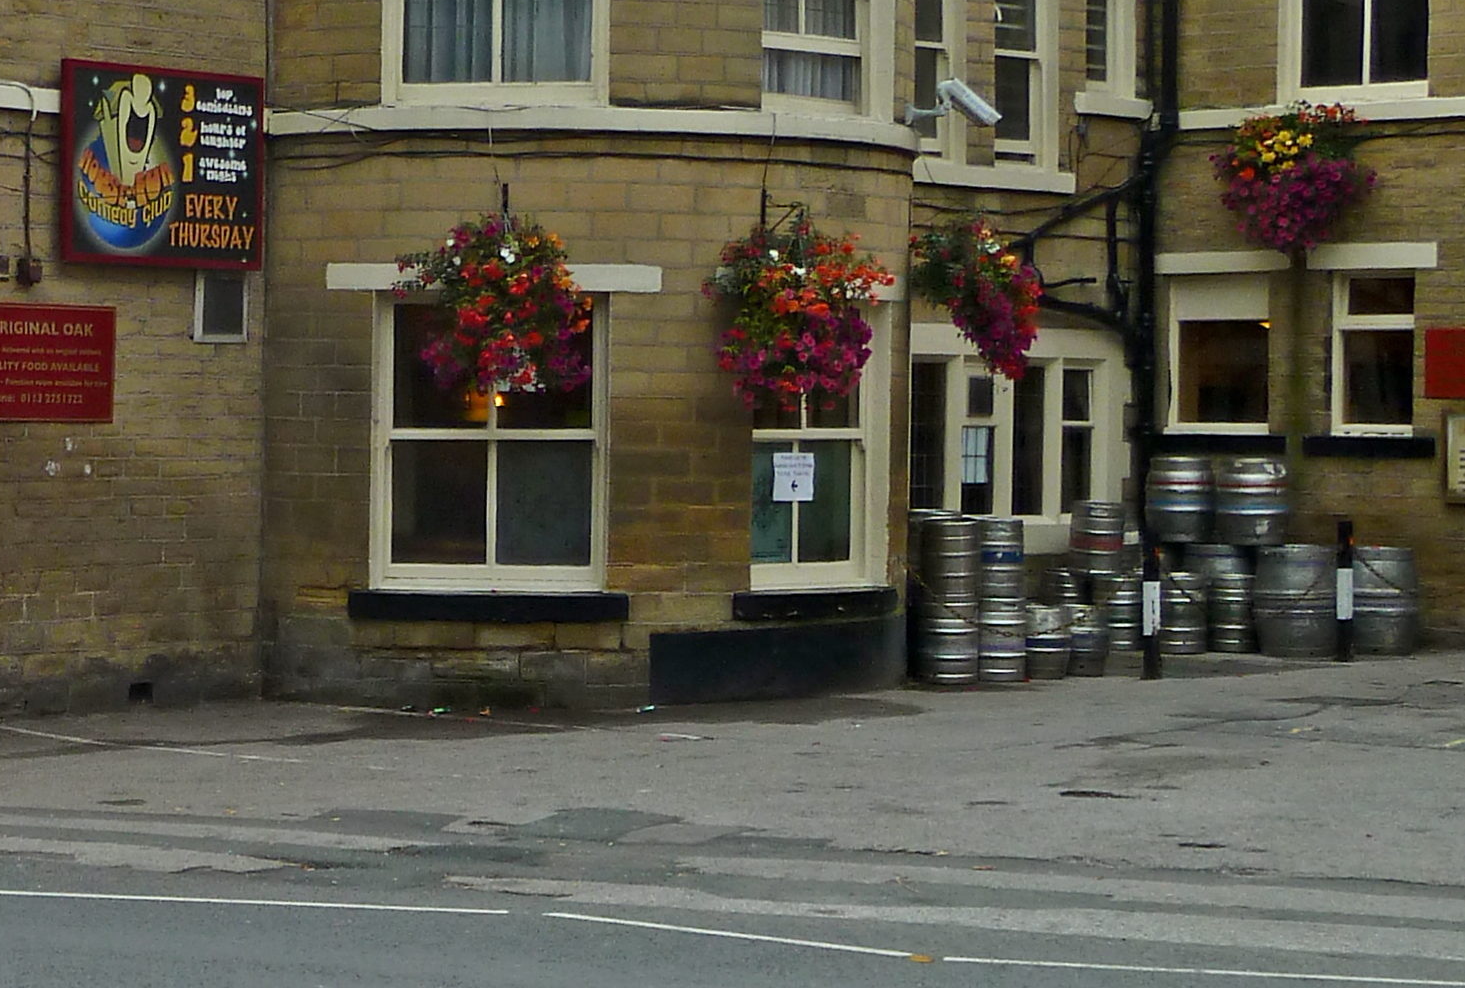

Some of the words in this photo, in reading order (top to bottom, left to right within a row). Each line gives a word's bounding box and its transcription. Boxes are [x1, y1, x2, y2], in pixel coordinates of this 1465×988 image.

[181, 83, 195, 112] 3
[180, 117, 198, 147] 2
[182, 153, 193, 182] 1
[185, 193, 238, 221] EVERY
[168, 222, 255, 251] THURSDAY
[63, 323, 93, 337] OAK
[22, 361, 49, 371] FOOD
